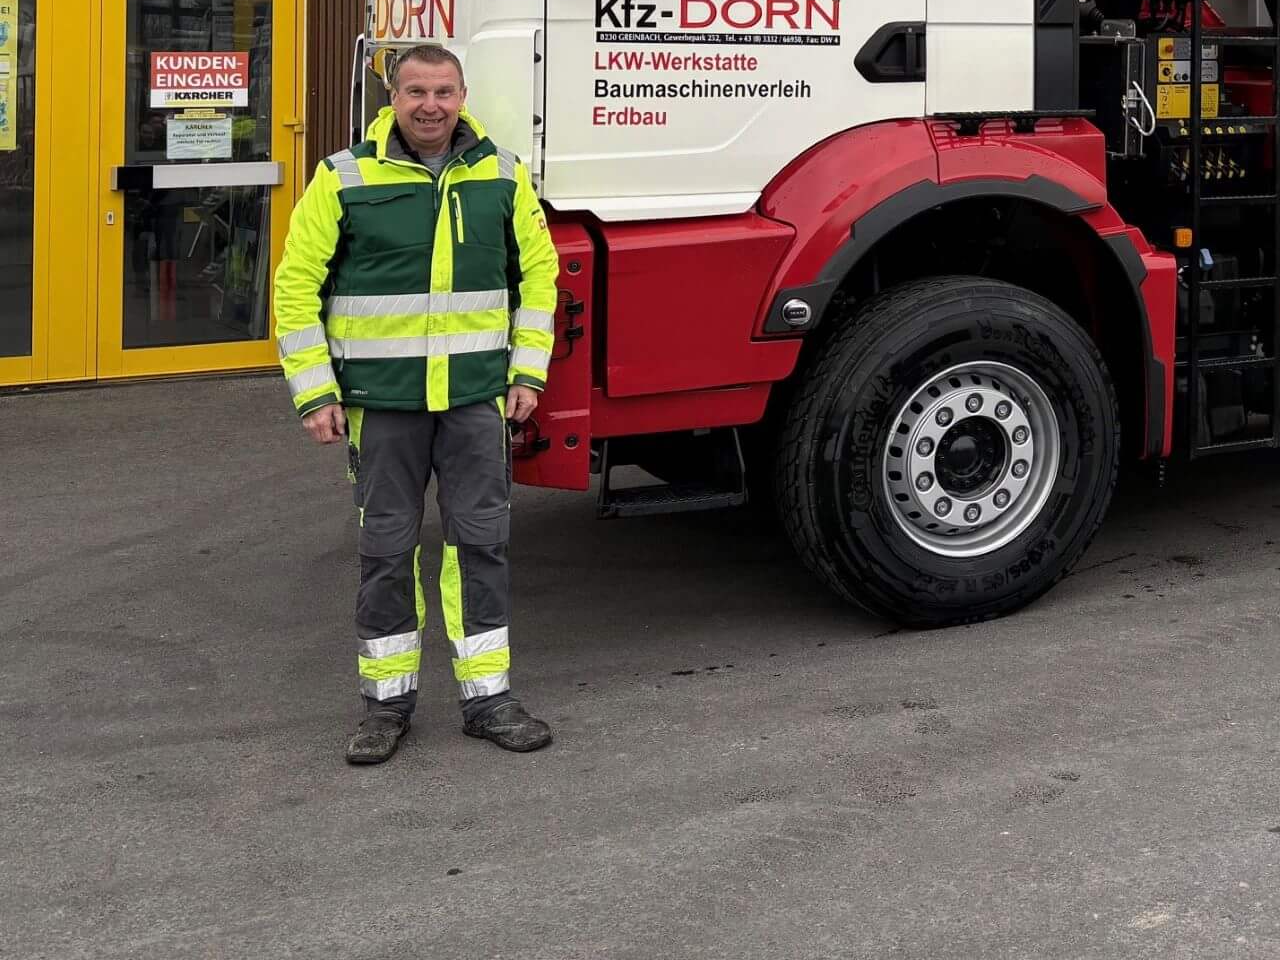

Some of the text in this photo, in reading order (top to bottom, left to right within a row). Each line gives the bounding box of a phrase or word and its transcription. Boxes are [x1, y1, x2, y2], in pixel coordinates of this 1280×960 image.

[156, 55, 244, 70] KUNDEN-
[594, 51, 759, 72] LKW-Werkstatte
[156, 73, 242, 88] EINGANG
[594, 79, 812, 99] Baumaschinenverleih
[174, 91, 234, 100] KÄRCHER
[592, 105, 668, 126] Erdbau
